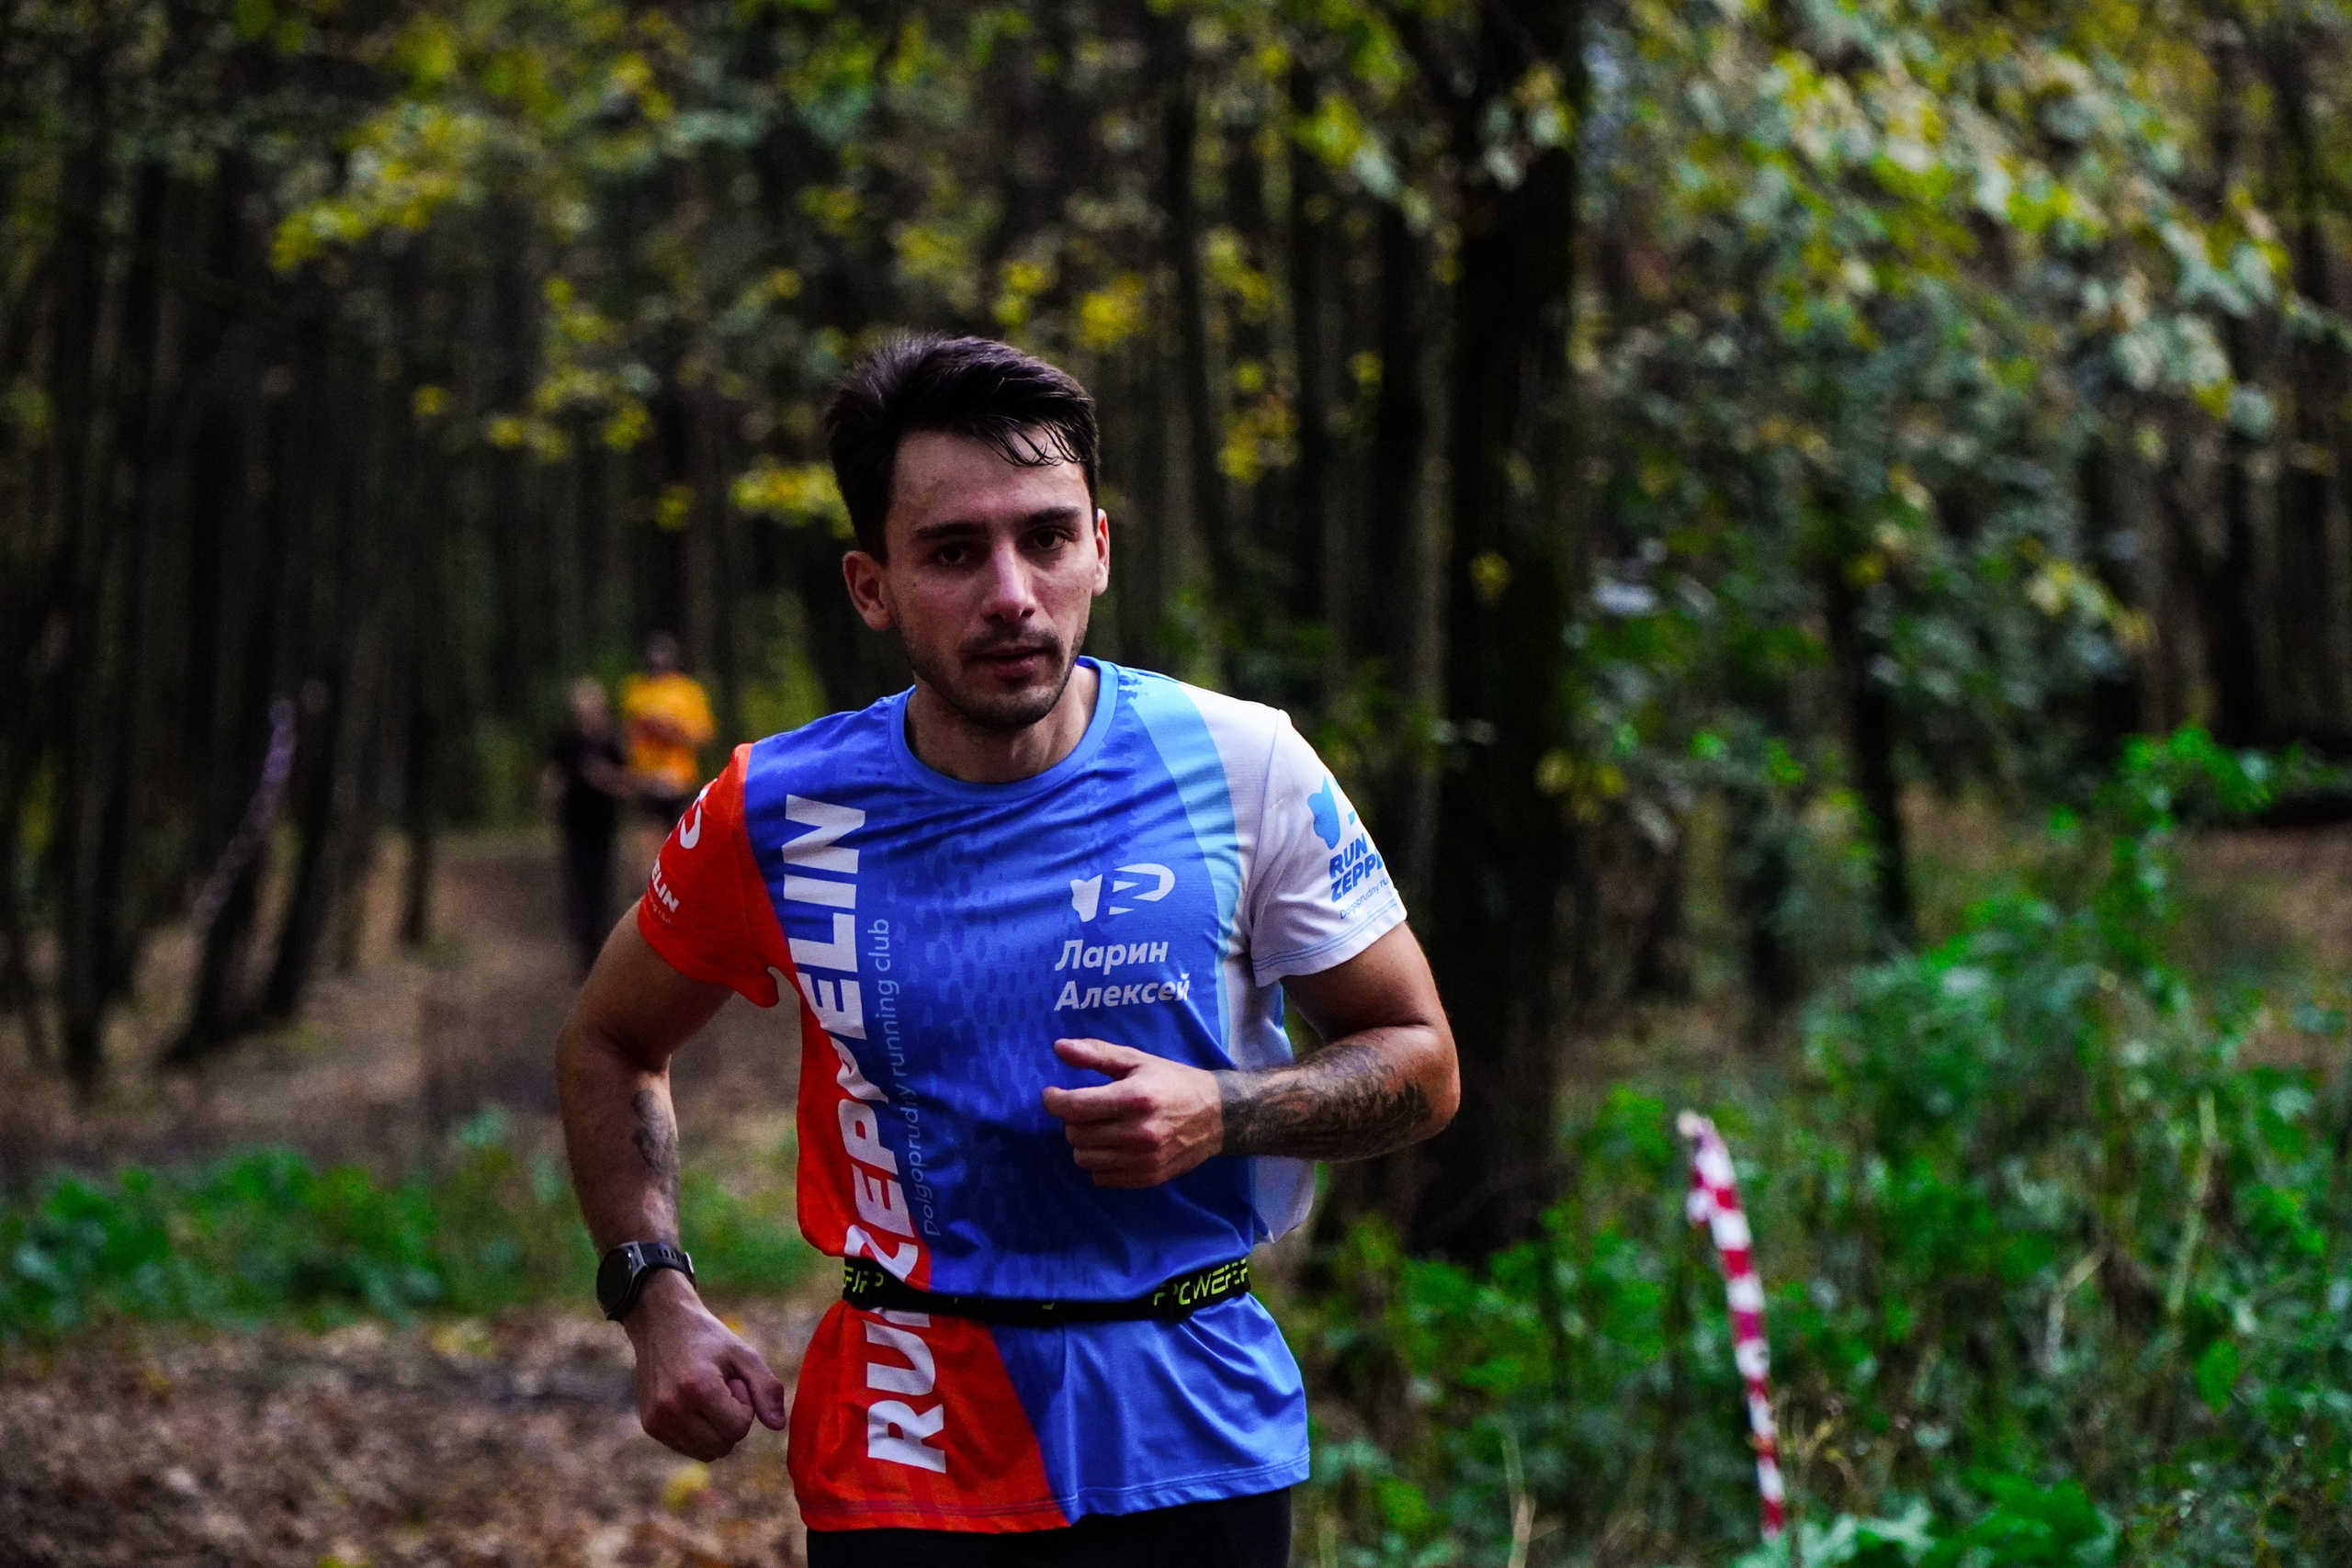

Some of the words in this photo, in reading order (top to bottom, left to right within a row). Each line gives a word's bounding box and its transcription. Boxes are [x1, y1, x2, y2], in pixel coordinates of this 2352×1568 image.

[1329, 832, 1368, 880] RUN
[1340, 883, 1380, 919] Dolgoprudny
[867, 917, 890, 973] club
[1055, 939, 1169, 976] Ларин
[1053, 972, 1191, 1011] Алексей
[781, 794, 920, 1282] ZEPPELIN
[875, 979, 908, 1077] running
[895, 1082, 941, 1236] Dolgoprudny
